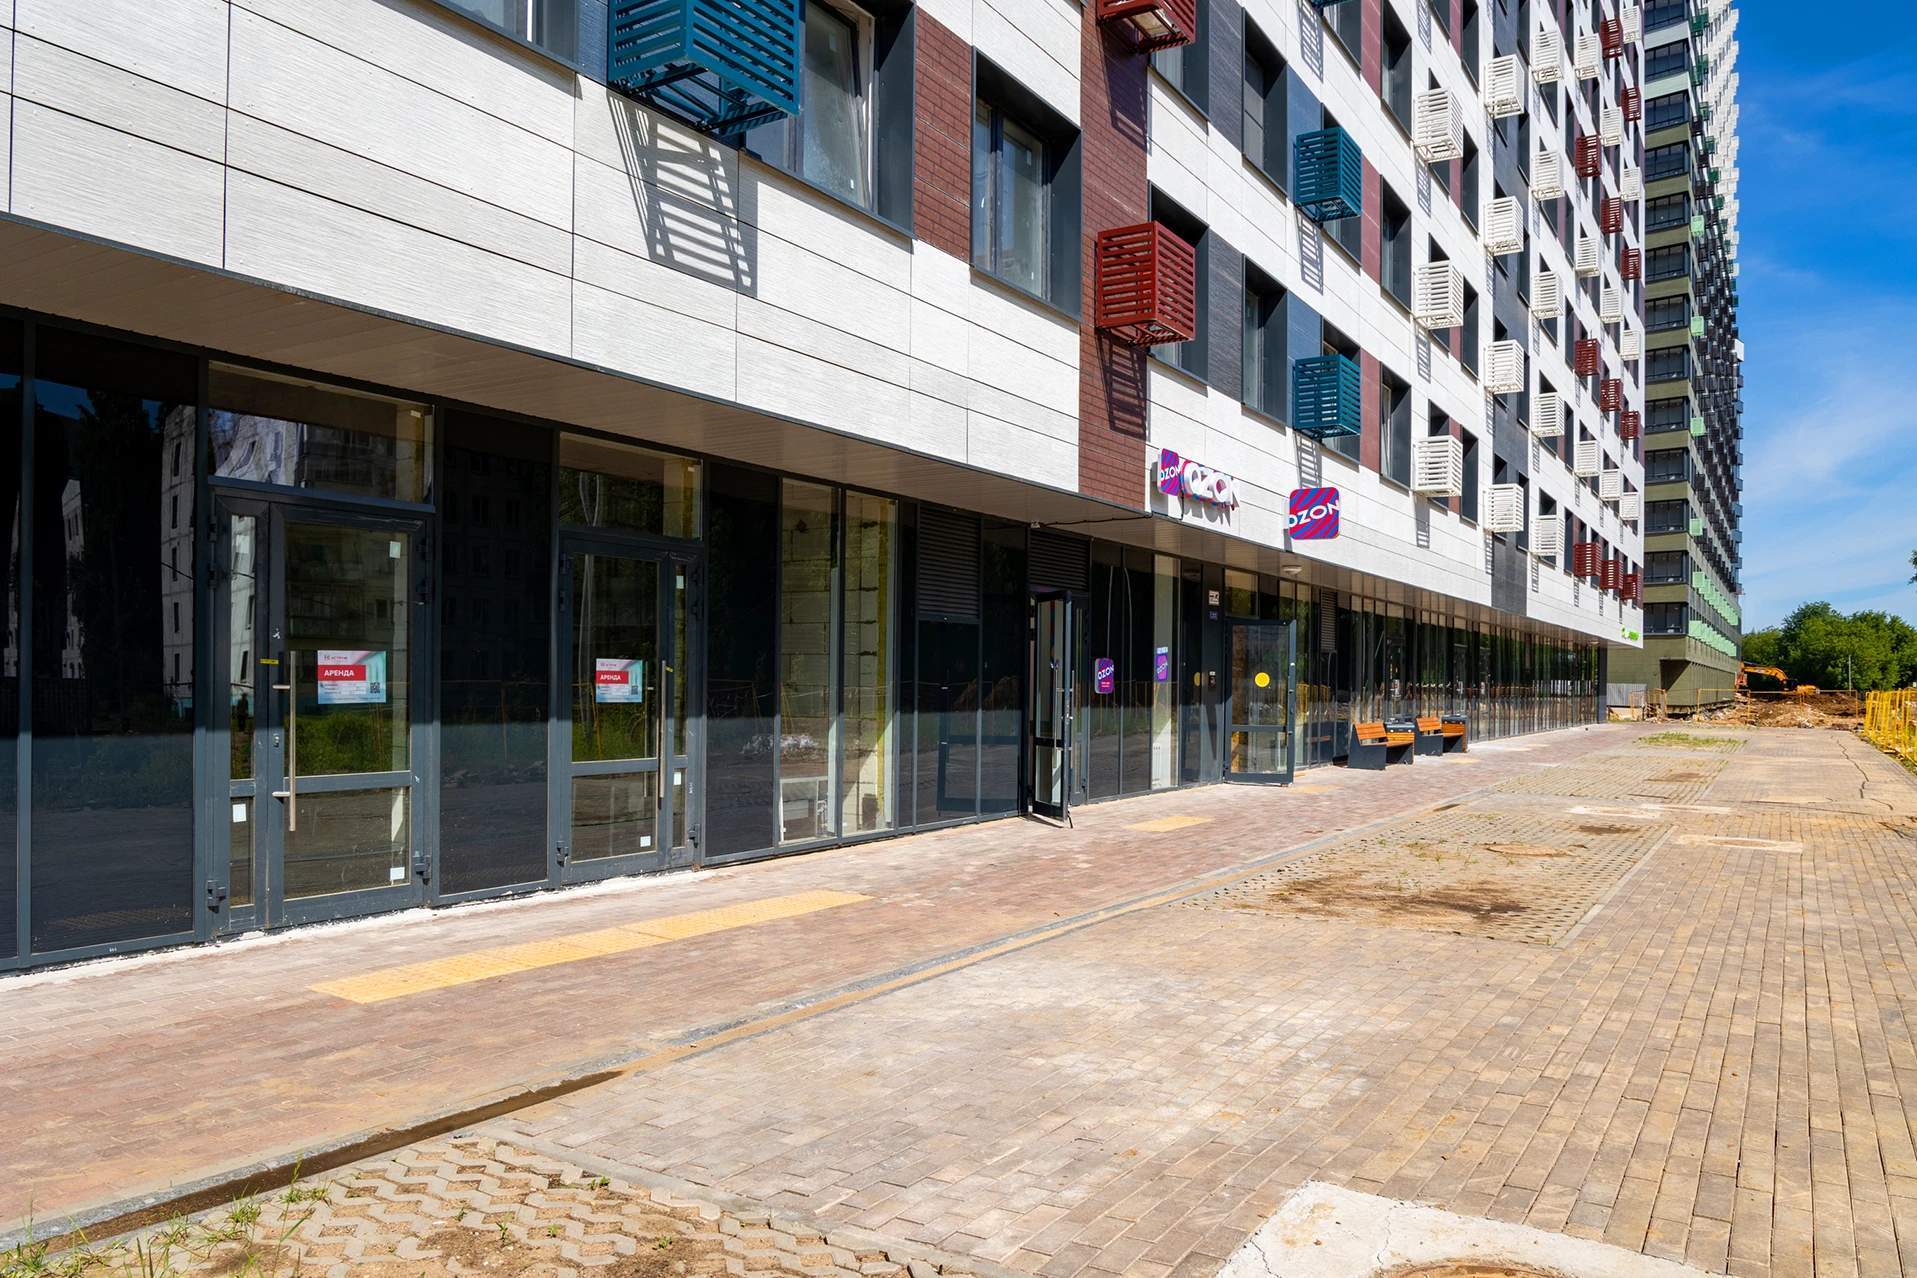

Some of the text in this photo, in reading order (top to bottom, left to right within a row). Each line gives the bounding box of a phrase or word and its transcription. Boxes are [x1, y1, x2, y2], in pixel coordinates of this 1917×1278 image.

[1160, 465, 1180, 480] OZON
[1289, 499, 1340, 528] OZON
[324, 669, 354, 677] АРЕНДА
[1097, 665, 1114, 680] OZON
